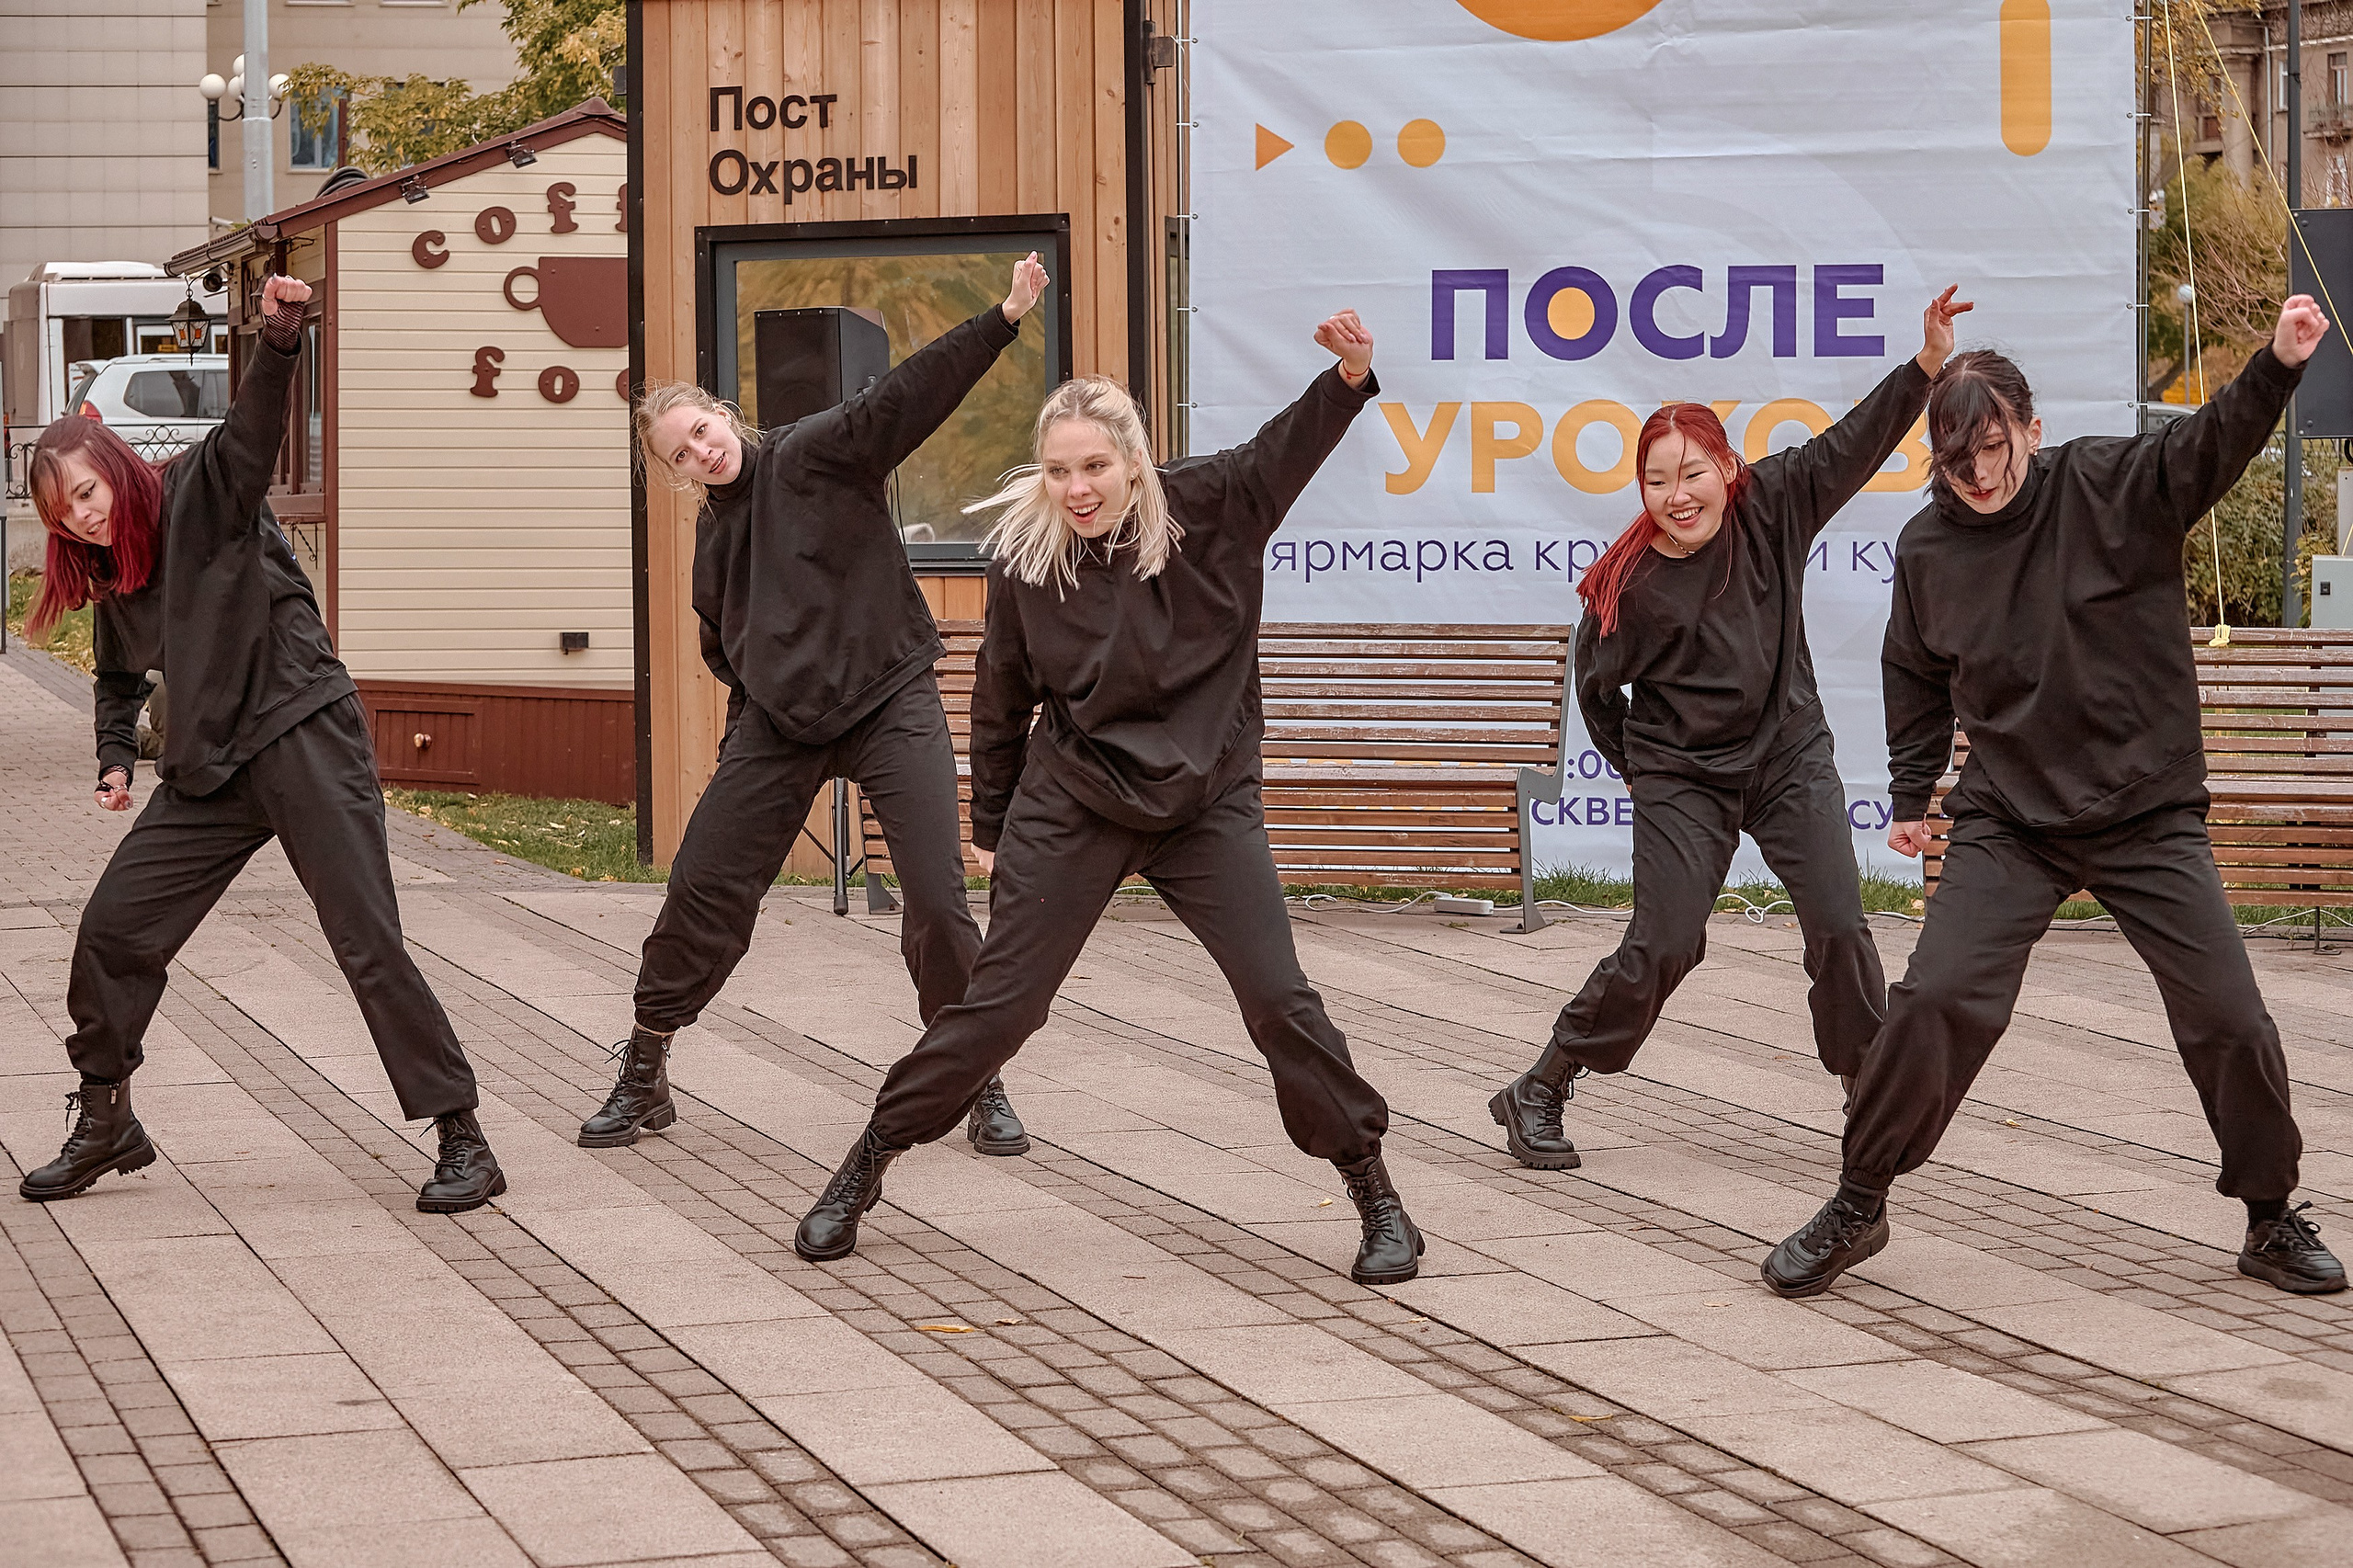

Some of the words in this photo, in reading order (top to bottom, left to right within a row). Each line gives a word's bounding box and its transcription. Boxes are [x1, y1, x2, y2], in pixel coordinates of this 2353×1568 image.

[710, 85, 838, 131] Пост
[709, 149, 918, 205] Охраны
[1430, 263, 1886, 361] ПОСЛЕ
[1378, 397, 1933, 494] УРООВ
[1269, 539, 1515, 584] ярмарка
[1535, 539, 1610, 584] кр
